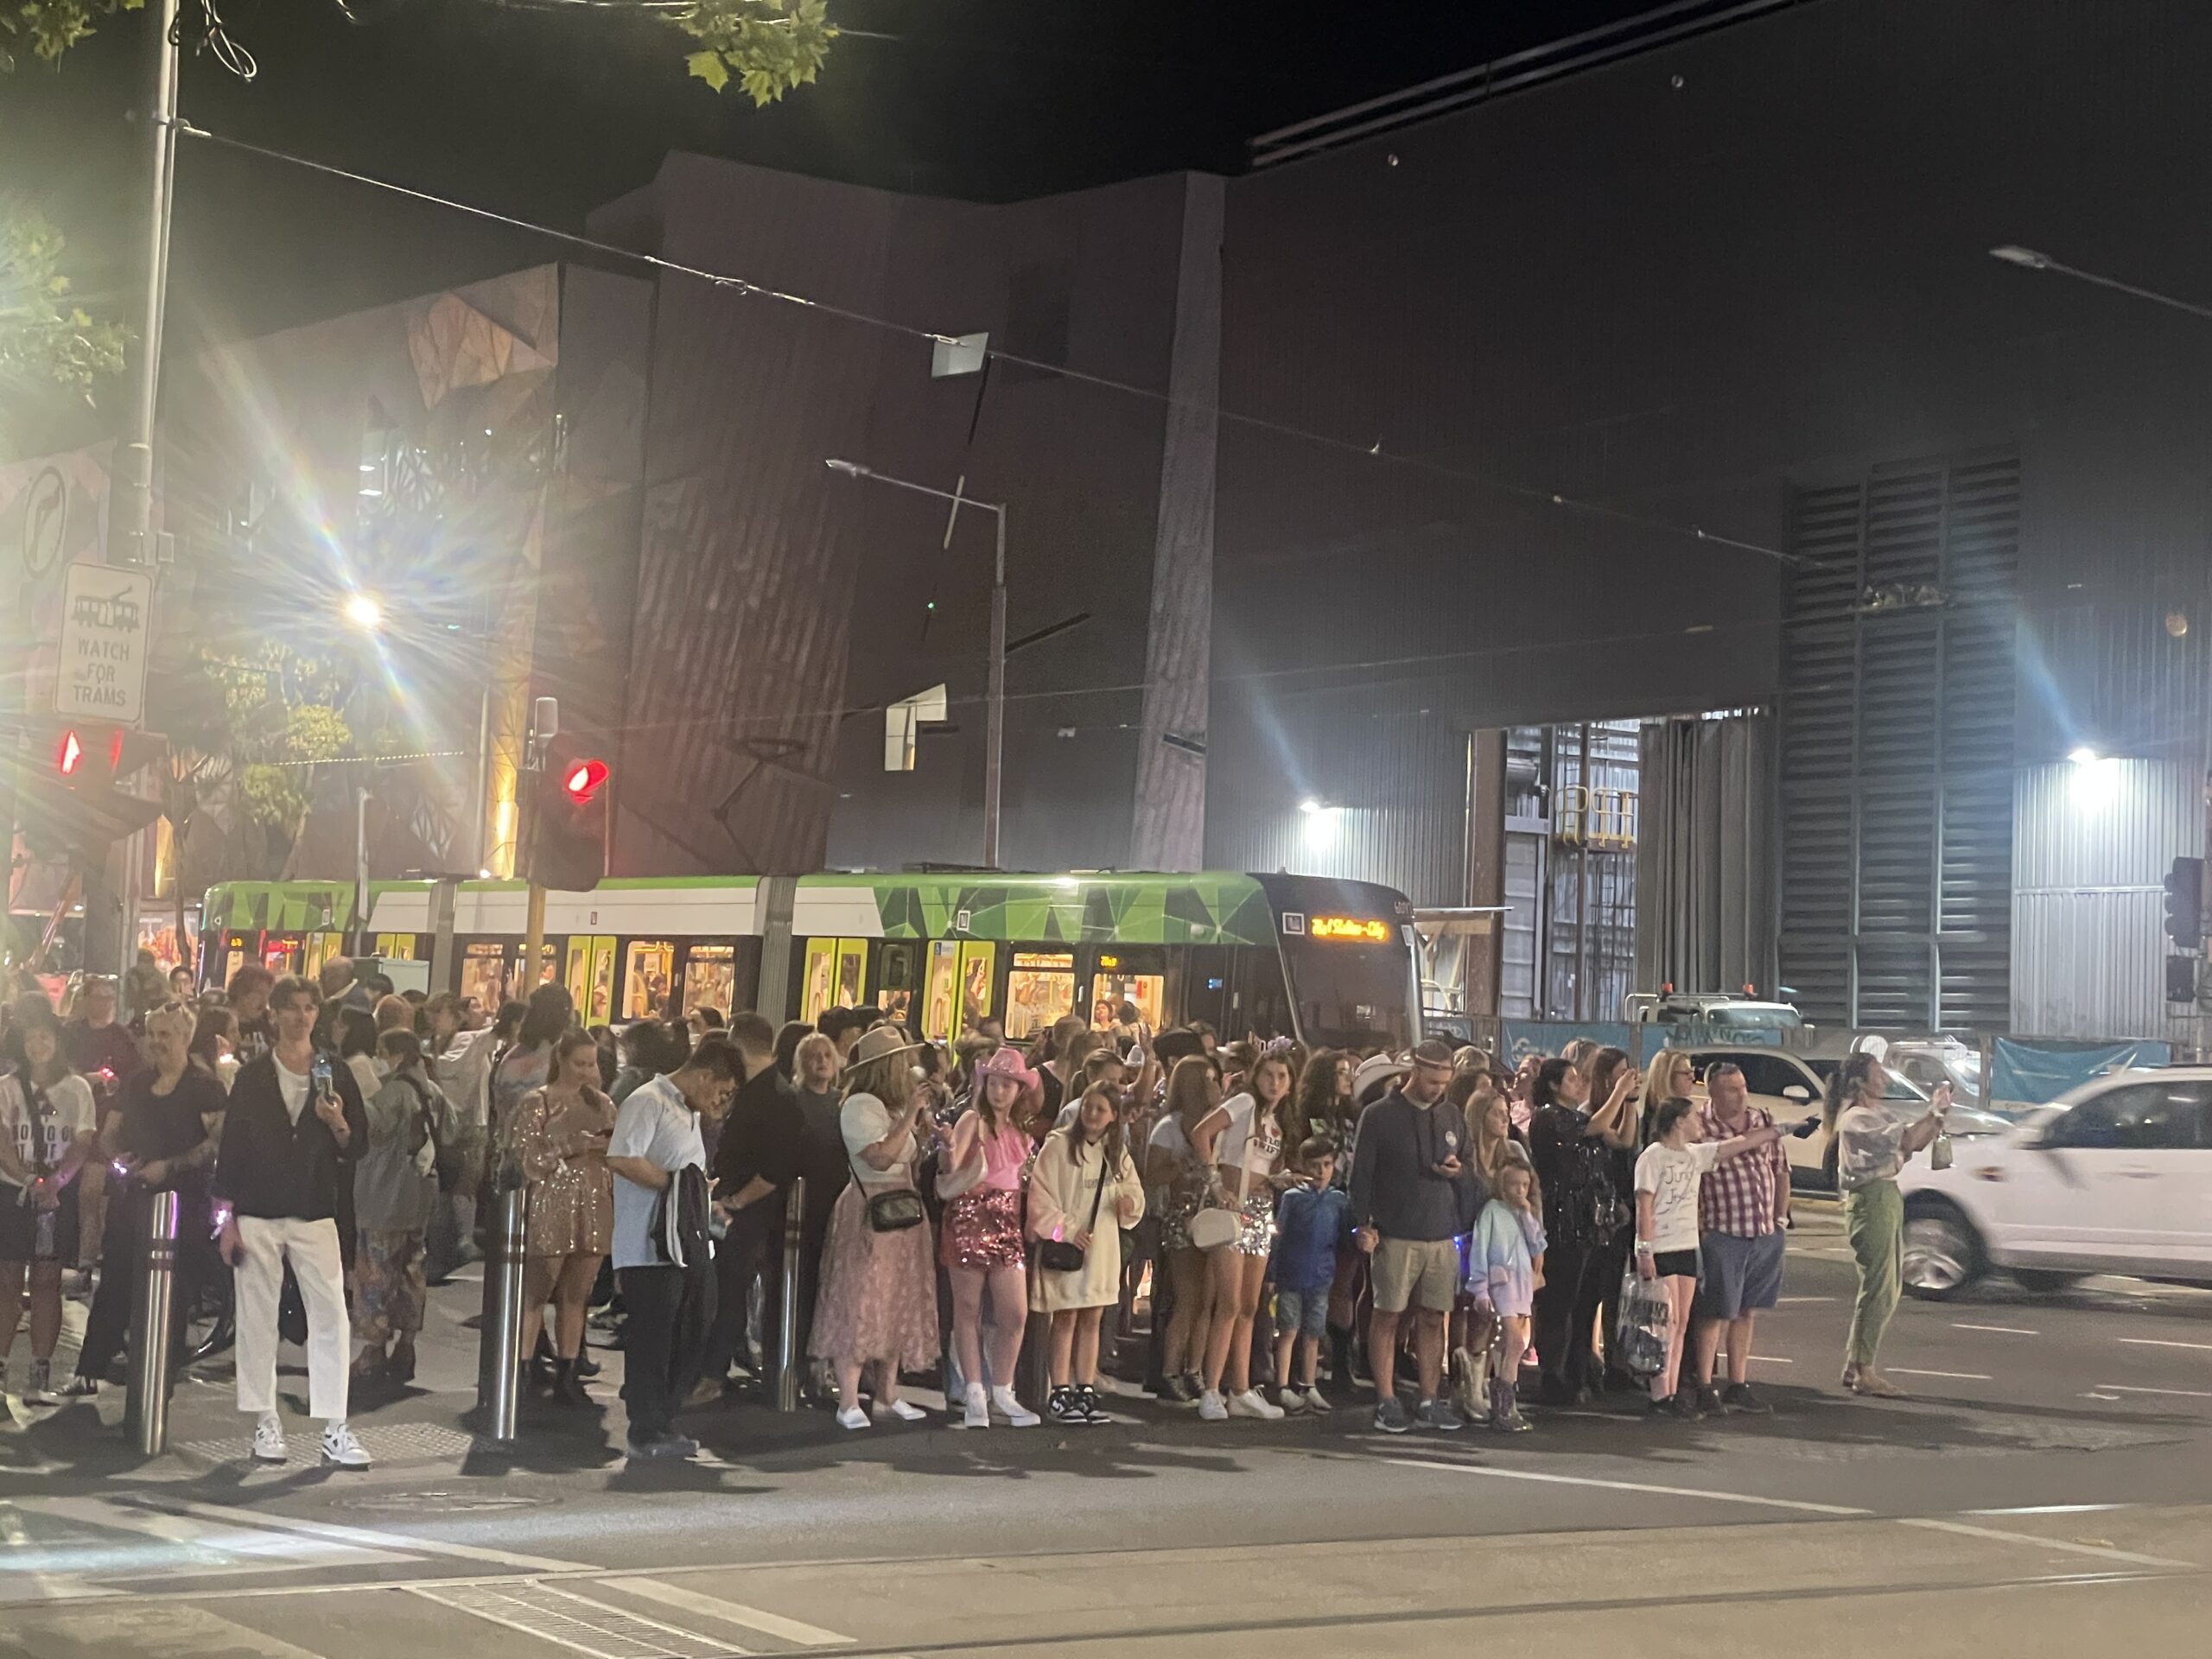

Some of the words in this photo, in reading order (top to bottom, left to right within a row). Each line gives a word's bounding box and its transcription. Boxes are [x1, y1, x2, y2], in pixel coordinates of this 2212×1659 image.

[78, 638, 130, 661] WATCH
[86, 662, 116, 683] FOR
[73, 684, 126, 707] TRAMS
